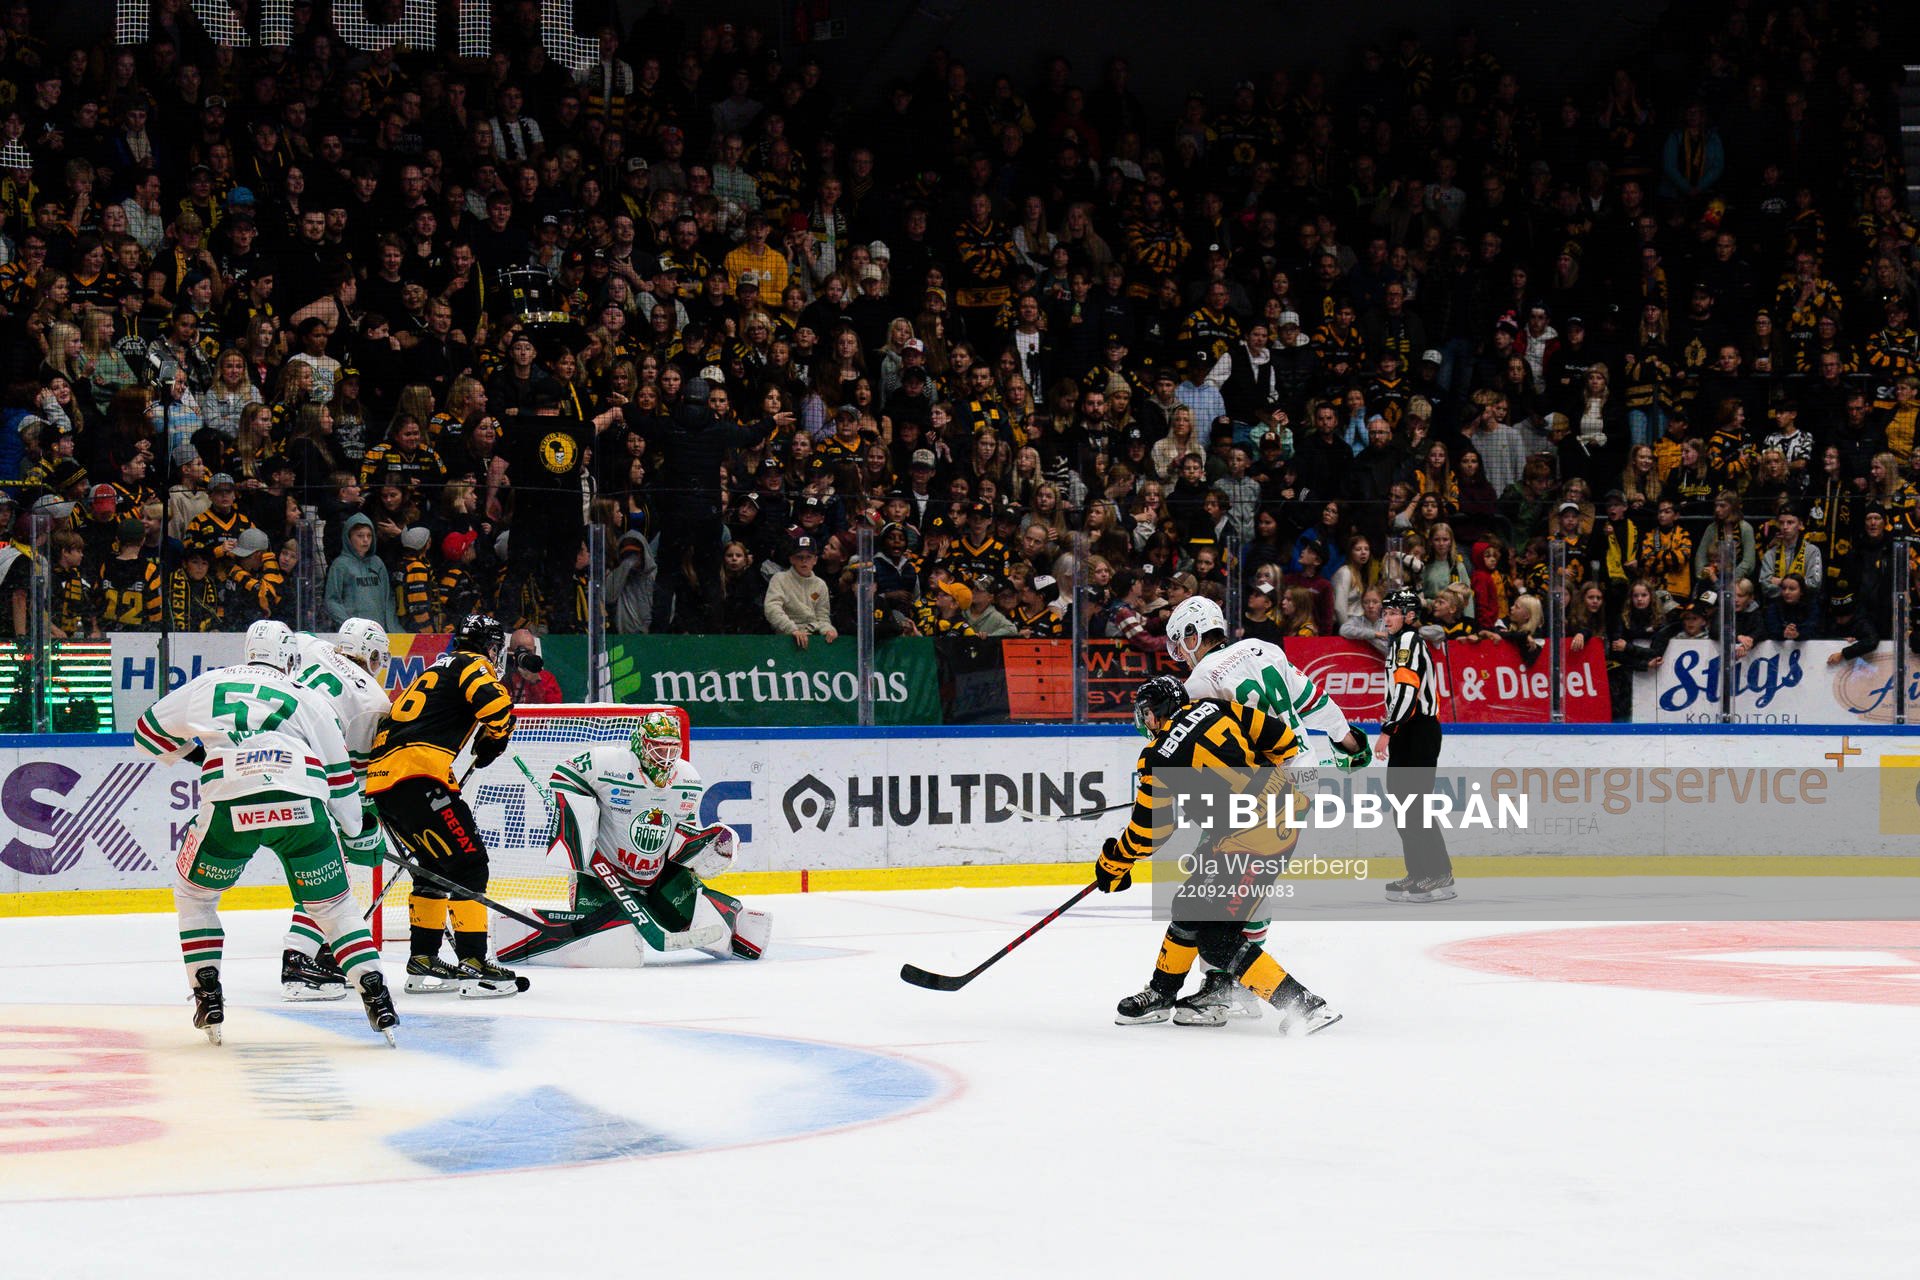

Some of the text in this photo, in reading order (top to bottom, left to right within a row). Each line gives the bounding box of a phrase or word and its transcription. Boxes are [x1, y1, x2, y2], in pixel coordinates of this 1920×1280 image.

[651, 658, 908, 703] martinsons
[1081, 651, 1183, 672] WOR
[1462, 667, 1485, 701] &
[212, 682, 299, 731] 57
[1162, 701, 1220, 757] BOLIDEN
[848, 771, 1107, 827] HULTDINS
[1490, 767, 1828, 814] energiservice
[441, 809, 477, 854] REPAY
[294, 859, 341, 878] CERNITOL
[304, 866, 343, 887] NOVUM
[592, 861, 650, 927] BAUER
